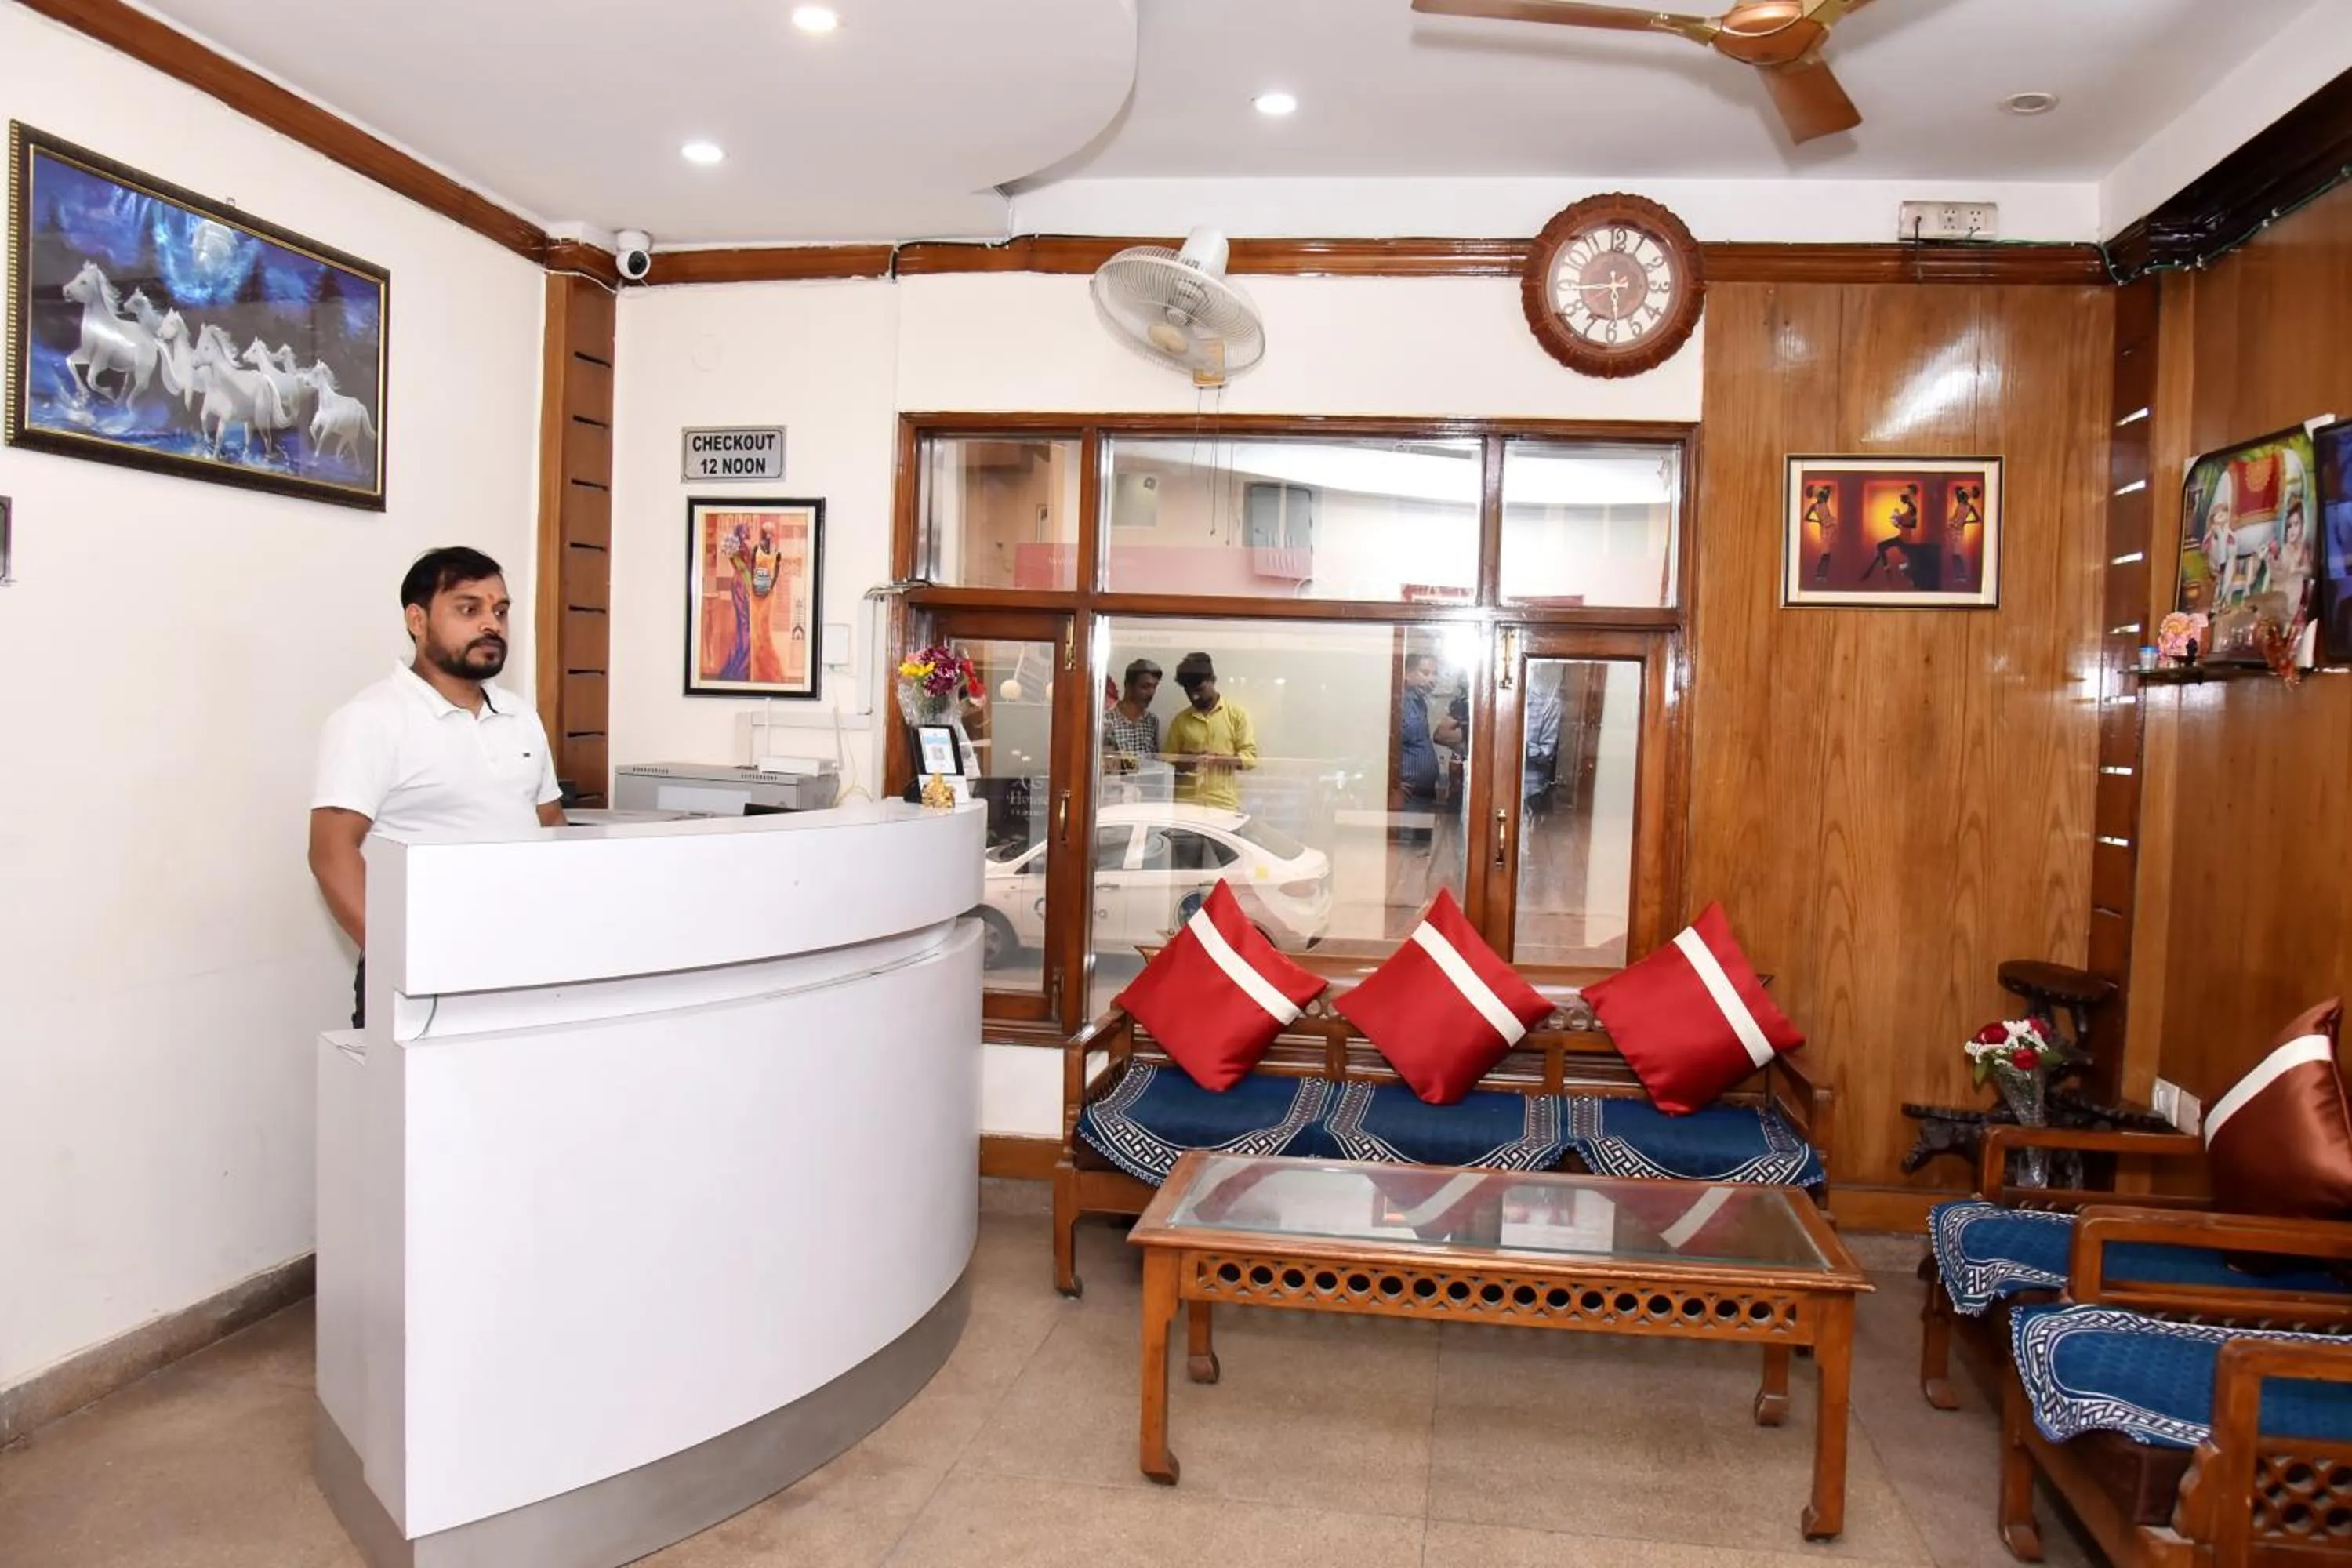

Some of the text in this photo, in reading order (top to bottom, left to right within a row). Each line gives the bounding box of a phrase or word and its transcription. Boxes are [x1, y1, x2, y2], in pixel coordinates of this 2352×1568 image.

[1581, 233, 1602, 256] 11
[1609, 227, 1628, 253] 12
[1633, 234, 1646, 254] 1
[1563, 248, 1592, 272] 10
[1642, 255, 1664, 273] 2
[1557, 278, 1579, 292] 9
[1648, 280, 1671, 293] 3
[1562, 299, 1586, 318] 8
[1645, 304, 1664, 320] 4
[1583, 313, 1598, 339] 7
[1605, 320, 1618, 343] 6
[1628, 317, 1642, 336] 5
[692, 434, 775, 452] CHECKOUT
[701, 458, 766, 474] 12 NOON
